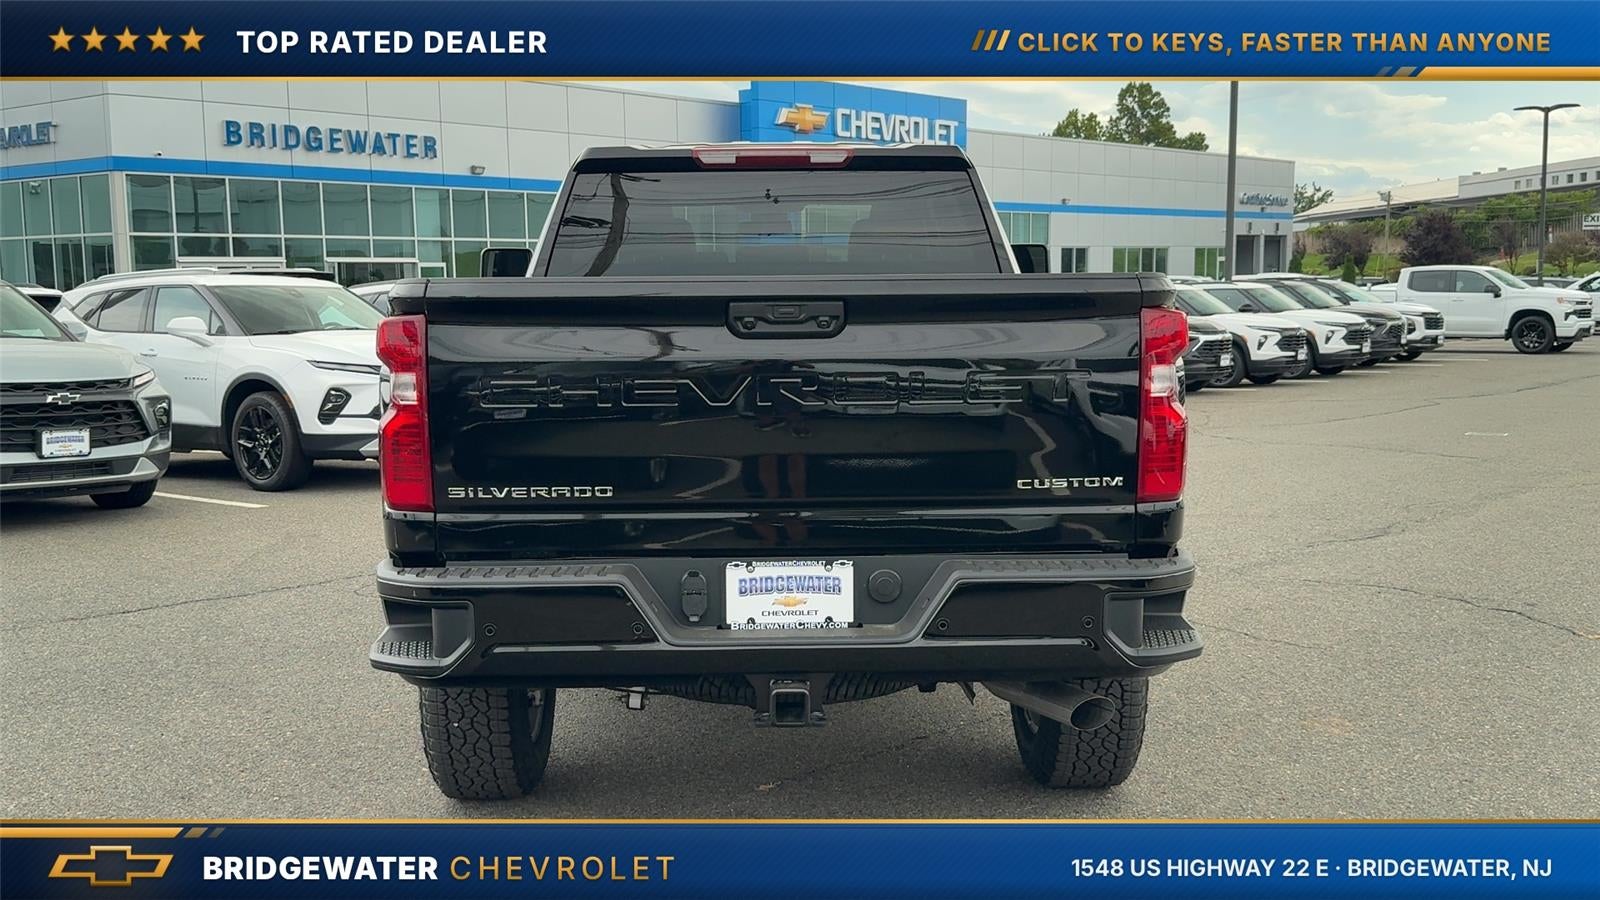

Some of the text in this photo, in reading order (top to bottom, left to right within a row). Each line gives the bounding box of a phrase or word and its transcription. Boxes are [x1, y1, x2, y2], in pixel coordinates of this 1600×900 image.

[836, 107, 959, 145] CHEVROLET
[223, 120, 438, 159] BRIDGEWATER
[479, 369, 1092, 408] CHEVROLET
[448, 486, 614, 499] SILVERADO
[1016, 476, 1124, 490] CUSTOM
[738, 575, 843, 597] BRIDGEWATER
[761, 609, 819, 617] CHEVROLET
